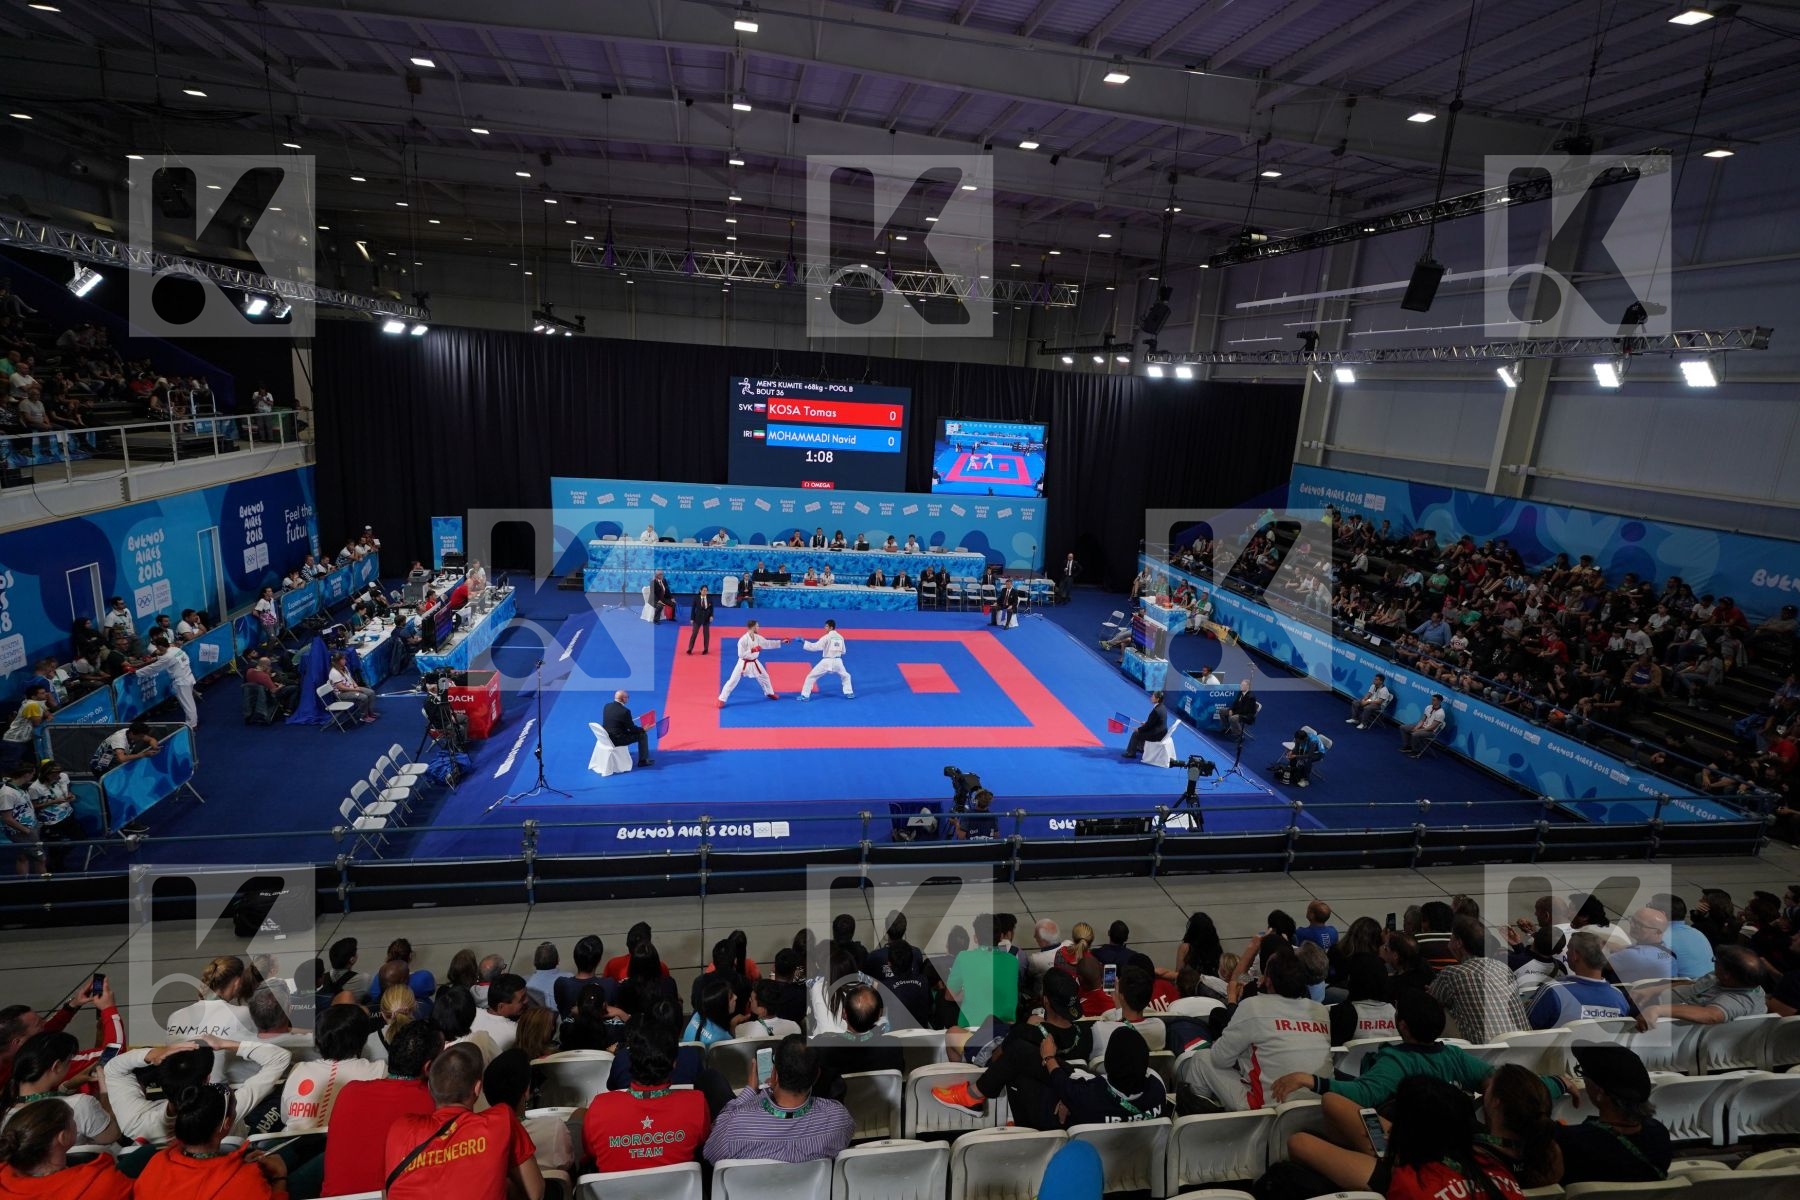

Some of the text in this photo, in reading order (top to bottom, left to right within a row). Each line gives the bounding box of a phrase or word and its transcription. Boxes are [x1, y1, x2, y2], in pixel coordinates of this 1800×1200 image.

[778, 382, 803, 390] KUMITE
[804, 383, 824, 392] +68kg
[769, 404, 801, 416] KOSA
[804, 406, 837, 418] Tomas
[890, 412, 896, 420] 0
[768, 430, 830, 443] MOHAMMADI
[832, 433, 856, 444] Navid
[888, 437, 895, 446] 0
[806, 451, 833, 463] 1:08
[1300, 483, 1362, 504] BUENOS AIRES 2018
[240, 501, 264, 518] BUENOS
[285, 504, 312, 523] Feel the
[244, 515, 262, 529] AIRES
[128, 528, 165, 551] BUENOS
[246, 527, 263, 545] 2018
[286, 522, 307, 544] futu
[136, 545, 161, 565] AIRES
[138, 560, 163, 583] 2018
[1510, 725, 1523, 737] 2018
[1547, 742, 1574, 759] BUENOS
[1593, 762, 1610, 775] 2018
[616, 824, 752, 840] BUENOS AIRS 2018
[168, 1026, 230, 1036] ENMARK
[1275, 1019, 1328, 1034] IR.IRAN
[1360, 1020, 1395, 1030] IR.IRA
[288, 1102, 319, 1118] JAPAN
[609, 1130, 685, 1148] MOROCCO
[405, 1136, 486, 1172] ONTENEGRO
[629, 1147, 663, 1158] TEAM
